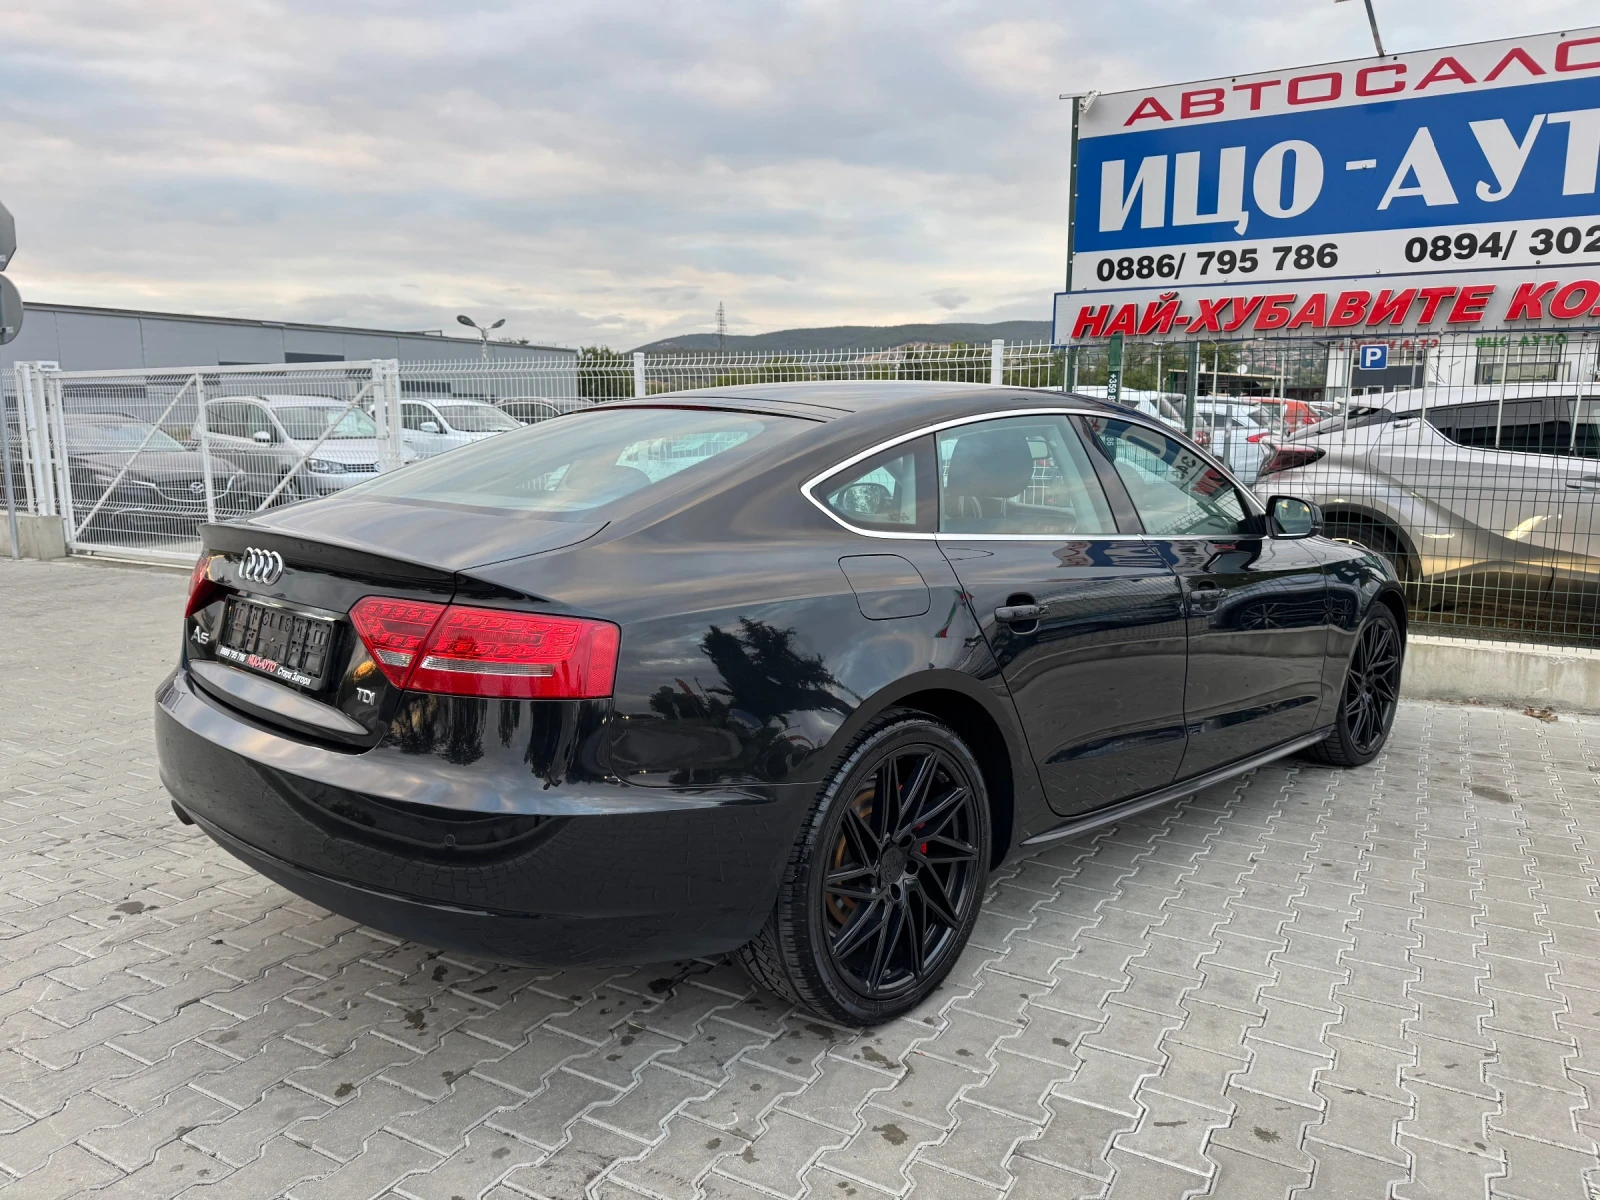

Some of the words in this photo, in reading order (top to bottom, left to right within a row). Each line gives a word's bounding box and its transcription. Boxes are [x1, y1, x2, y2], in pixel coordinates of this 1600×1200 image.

[1404, 229, 1519, 263] 0894/
[1528, 224, 1600, 256] 302
[1096, 252, 1187, 282] 0886/
[1197, 247, 1259, 276] 795
[1272, 242, 1339, 272] 786
[1070, 283, 1498, 339] НАЙ-ХУБАВИТЕ
[1503, 278, 1600, 322] КО
[1365, 347, 1383, 367] P
[1108, 373, 1118, 393] +359
[1107, 395, 1117, 403] 8
[190, 625, 210, 645] A5
[355, 686, 376, 706] TDI
